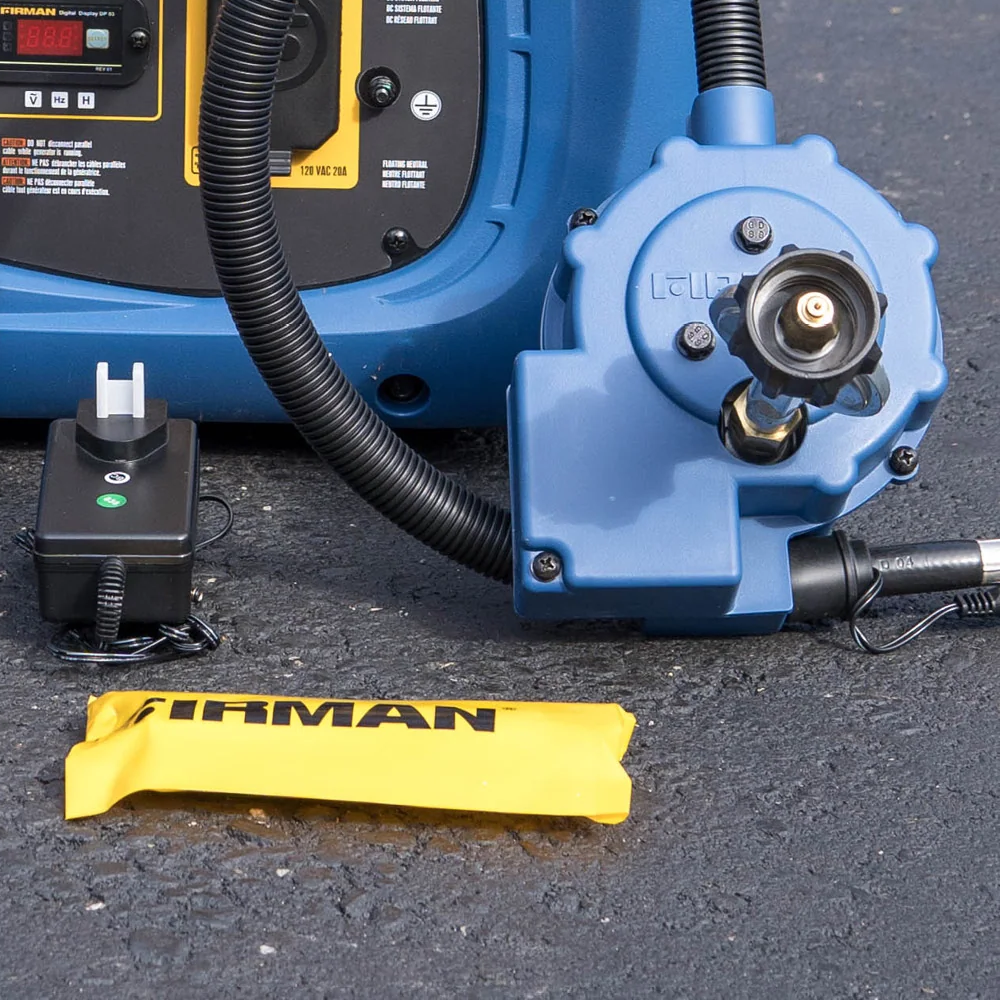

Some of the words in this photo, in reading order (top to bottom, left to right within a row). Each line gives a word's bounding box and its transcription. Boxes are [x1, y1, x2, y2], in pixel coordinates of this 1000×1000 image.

[0, 7, 56, 16] FIRMAN
[83, 96, 90, 104] H
[301, 165, 313, 176] 120
[316, 165, 331, 176] VAC
[333, 165, 347, 176] 20A
